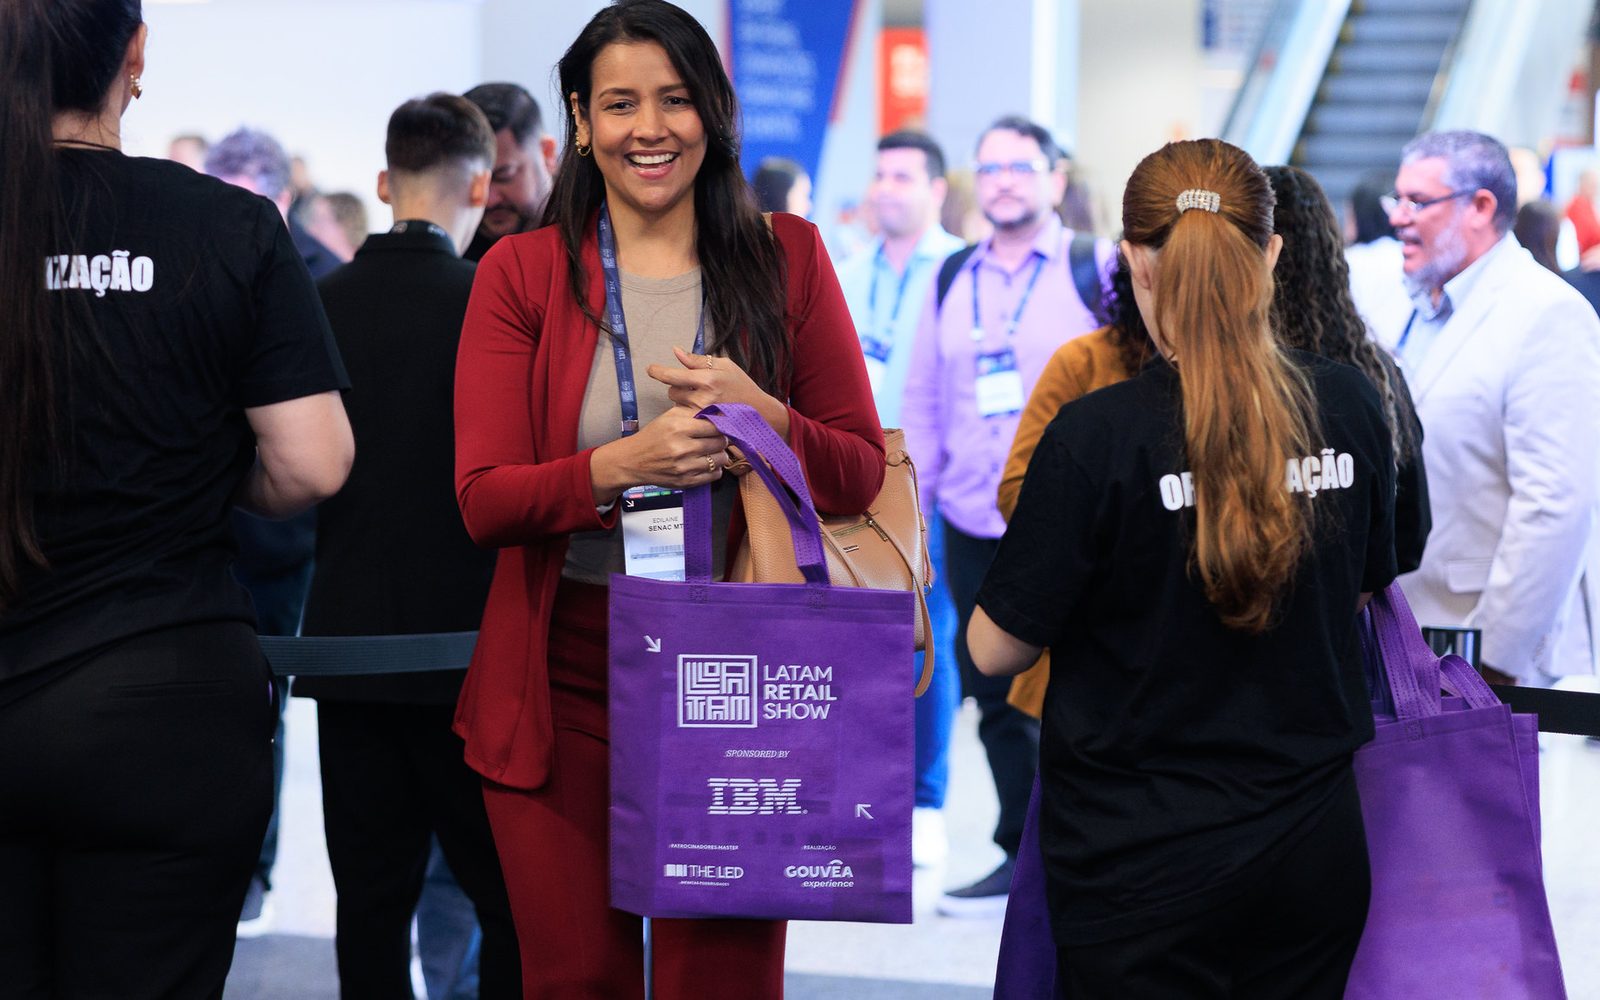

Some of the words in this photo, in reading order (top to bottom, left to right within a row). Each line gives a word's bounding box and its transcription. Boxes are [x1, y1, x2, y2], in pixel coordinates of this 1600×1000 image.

[46, 250, 154, 297] IZAÇÃO
[1159, 448, 1354, 511] ORAÇÃO
[648, 524, 672, 532] SENAC
[763, 664, 833, 682] LATAM
[763, 684, 838, 701] RETAIL
[762, 702, 831, 720] SHOW
[725, 749, 777, 759] SPONSORED
[778, 750, 790, 759] BY
[707, 778, 802, 815] IBM
[688, 864, 716, 878] THE
[717, 865, 745, 880] LED
[801, 880, 855, 889] experience
